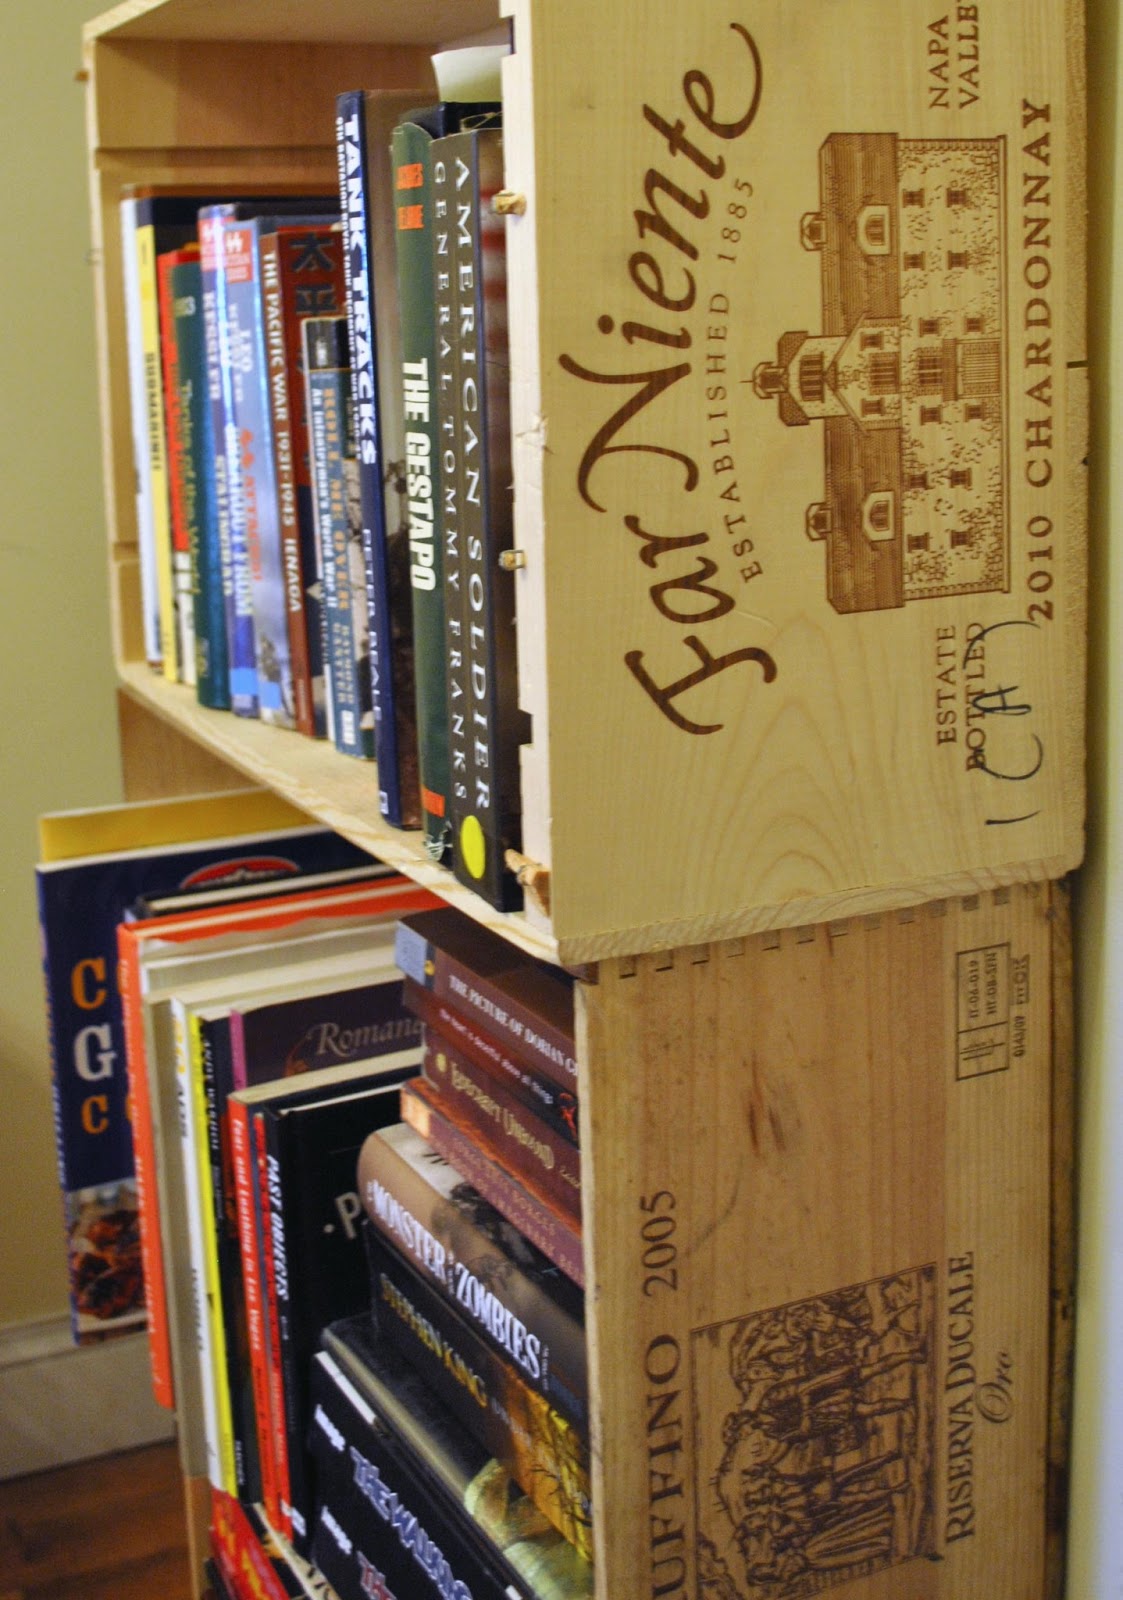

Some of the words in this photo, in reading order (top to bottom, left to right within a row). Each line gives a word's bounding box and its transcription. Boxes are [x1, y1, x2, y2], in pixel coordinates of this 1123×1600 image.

[926, 14, 950, 110] NAPA
[956, 0, 980, 110] VALLE
[344, 113, 365, 251] TANK
[716, 178, 754, 265] 1885
[262, 250, 277, 289] THE
[434, 162, 454, 390] GENERAL
[557, 22, 763, 514] Niente
[1022, 98, 1053, 489] CHARDONNAY
[266, 292, 284, 368] PACIFIC
[352, 269, 378, 466] TRACKS
[455, 156, 482, 509] AMERICAN
[274, 372, 289, 421] WAR
[402, 357, 431, 423] THE
[705, 292, 764, 585] ESTABLISHED
[277, 430, 296, 527] 1931-1945
[404, 431, 437, 591] GESTAPO
[442, 415, 461, 592] TOMMY
[285, 537, 302, 614] IENAGA
[321, 513, 336, 559] World
[323, 561, 337, 593] War
[1026, 516, 1054, 623] 2010
[467, 535, 491, 810] SOLDIER
[623, 514, 779, 736] Far
[448, 618, 468, 800] FRANKS
[935, 624, 959, 748] ESTATE
[963, 622, 988, 774] BOTTLED
[232, 1118, 247, 1150] Fear
[235, 1155, 249, 1186] and
[266, 1154, 283, 1211] PAST
[240, 1189, 258, 1252] Loathing
[246, 1257, 256, 1273] in
[271, 1211, 291, 1304] OBJECTS
[640, 1192, 679, 1301] 2005
[248, 1276, 259, 1303] Las
[249, 1308, 263, 1351] Vegas
[455, 1261, 542, 1379] ZOMBIES
[943, 1251, 977, 1393] DUCALE
[975, 1352, 1014, 1425] Oro
[643, 1333, 690, 1600] UFFINO
[943, 1396, 977, 1545] RISERVA
